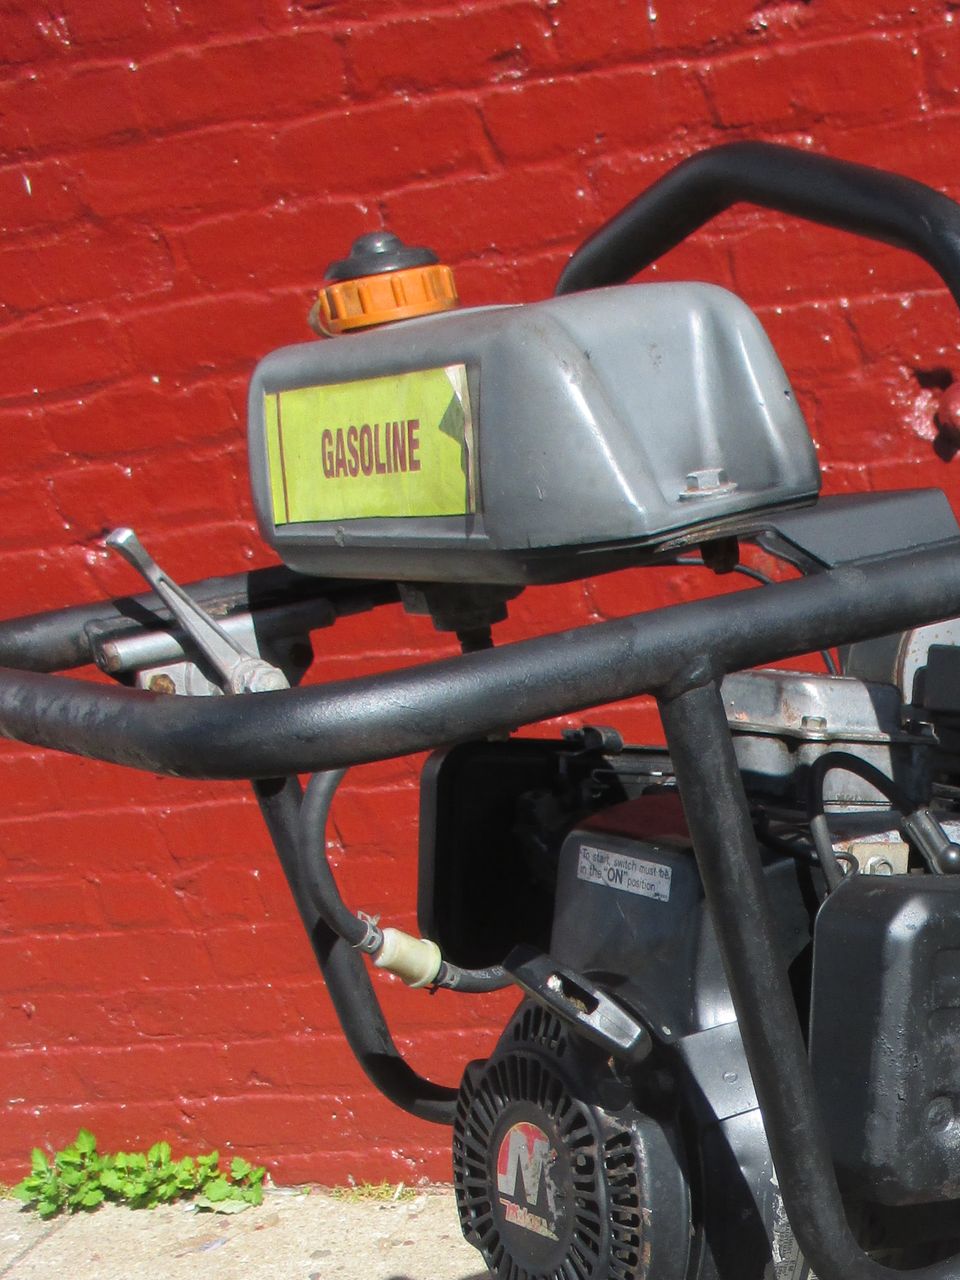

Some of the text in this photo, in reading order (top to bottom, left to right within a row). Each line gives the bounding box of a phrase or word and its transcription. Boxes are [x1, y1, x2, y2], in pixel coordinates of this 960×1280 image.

[321, 418, 421, 479] GASOLINE
[581, 848, 590, 859] To
[614, 859, 637, 871] switch
[639, 864, 657, 876] must
[581, 862, 656, 892] in the "ON" position
